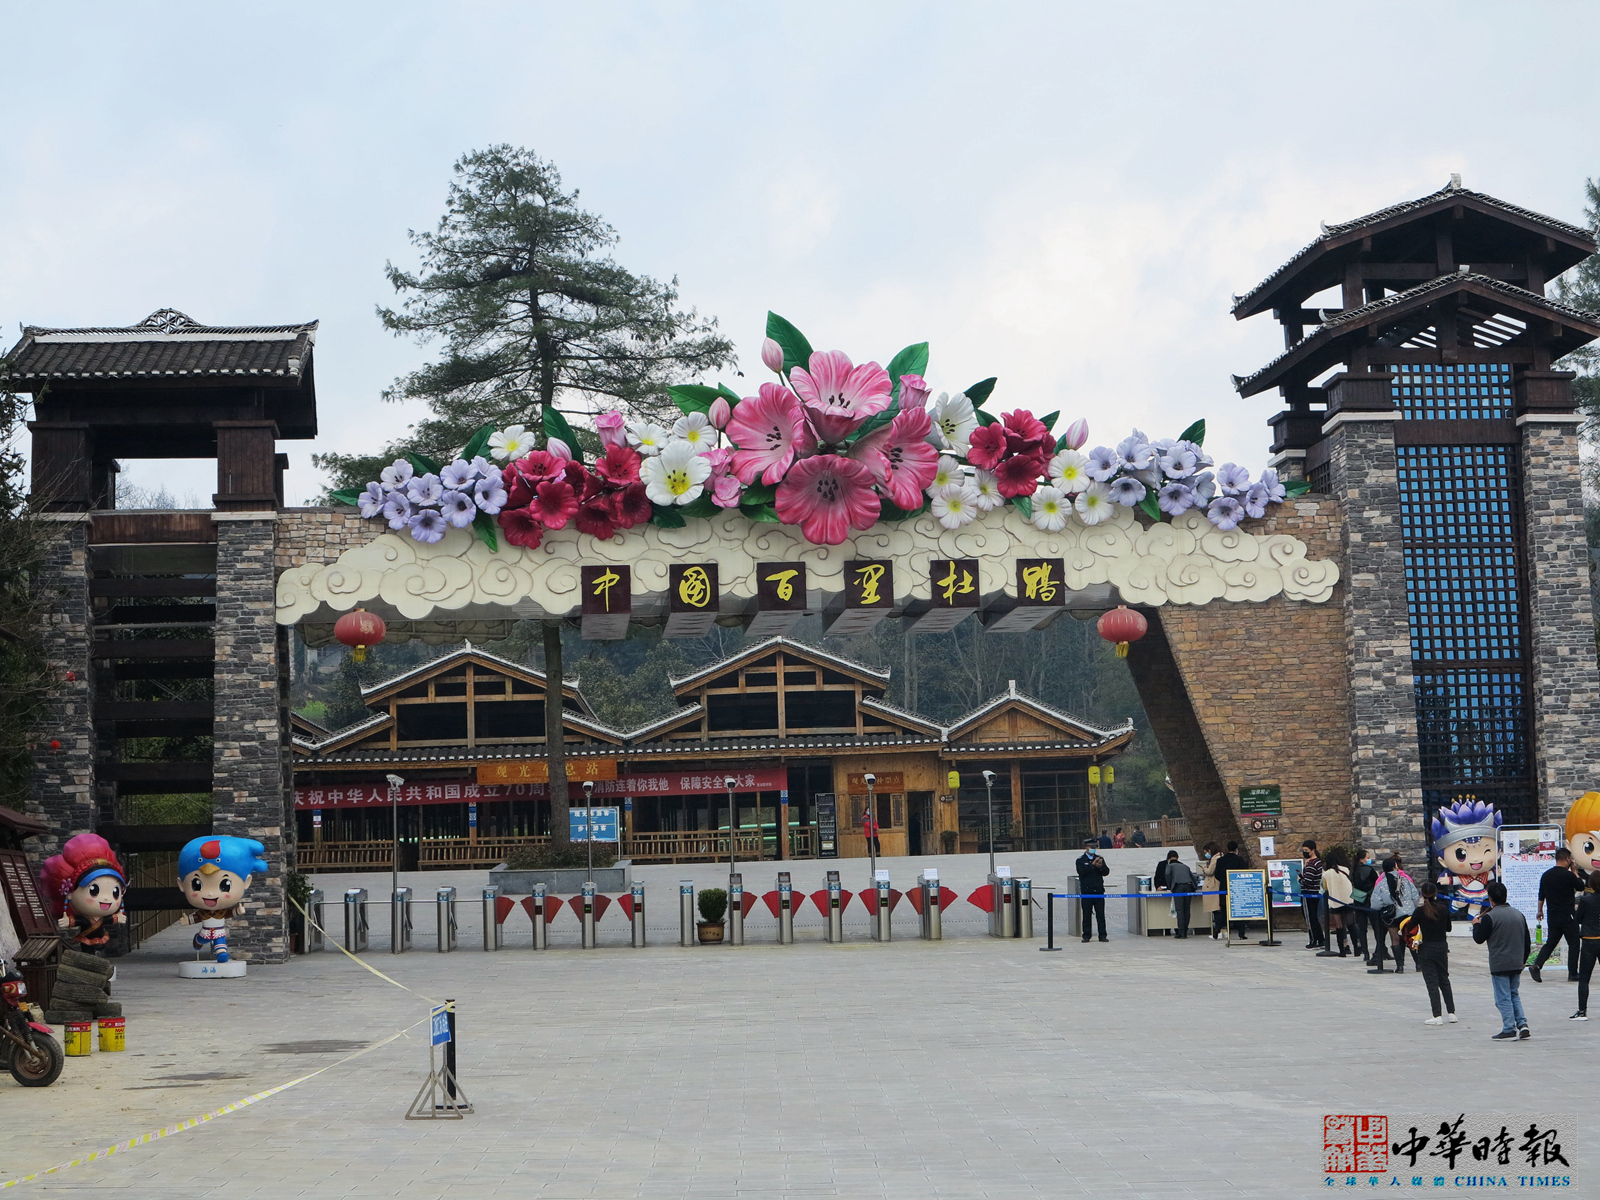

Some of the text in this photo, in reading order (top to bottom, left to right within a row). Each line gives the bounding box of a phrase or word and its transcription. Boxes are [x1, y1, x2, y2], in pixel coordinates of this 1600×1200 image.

[293, 783, 550, 805] 庆祝中华人民共和国成立70周
[595, 778, 669, 793] 消防连着你我他
